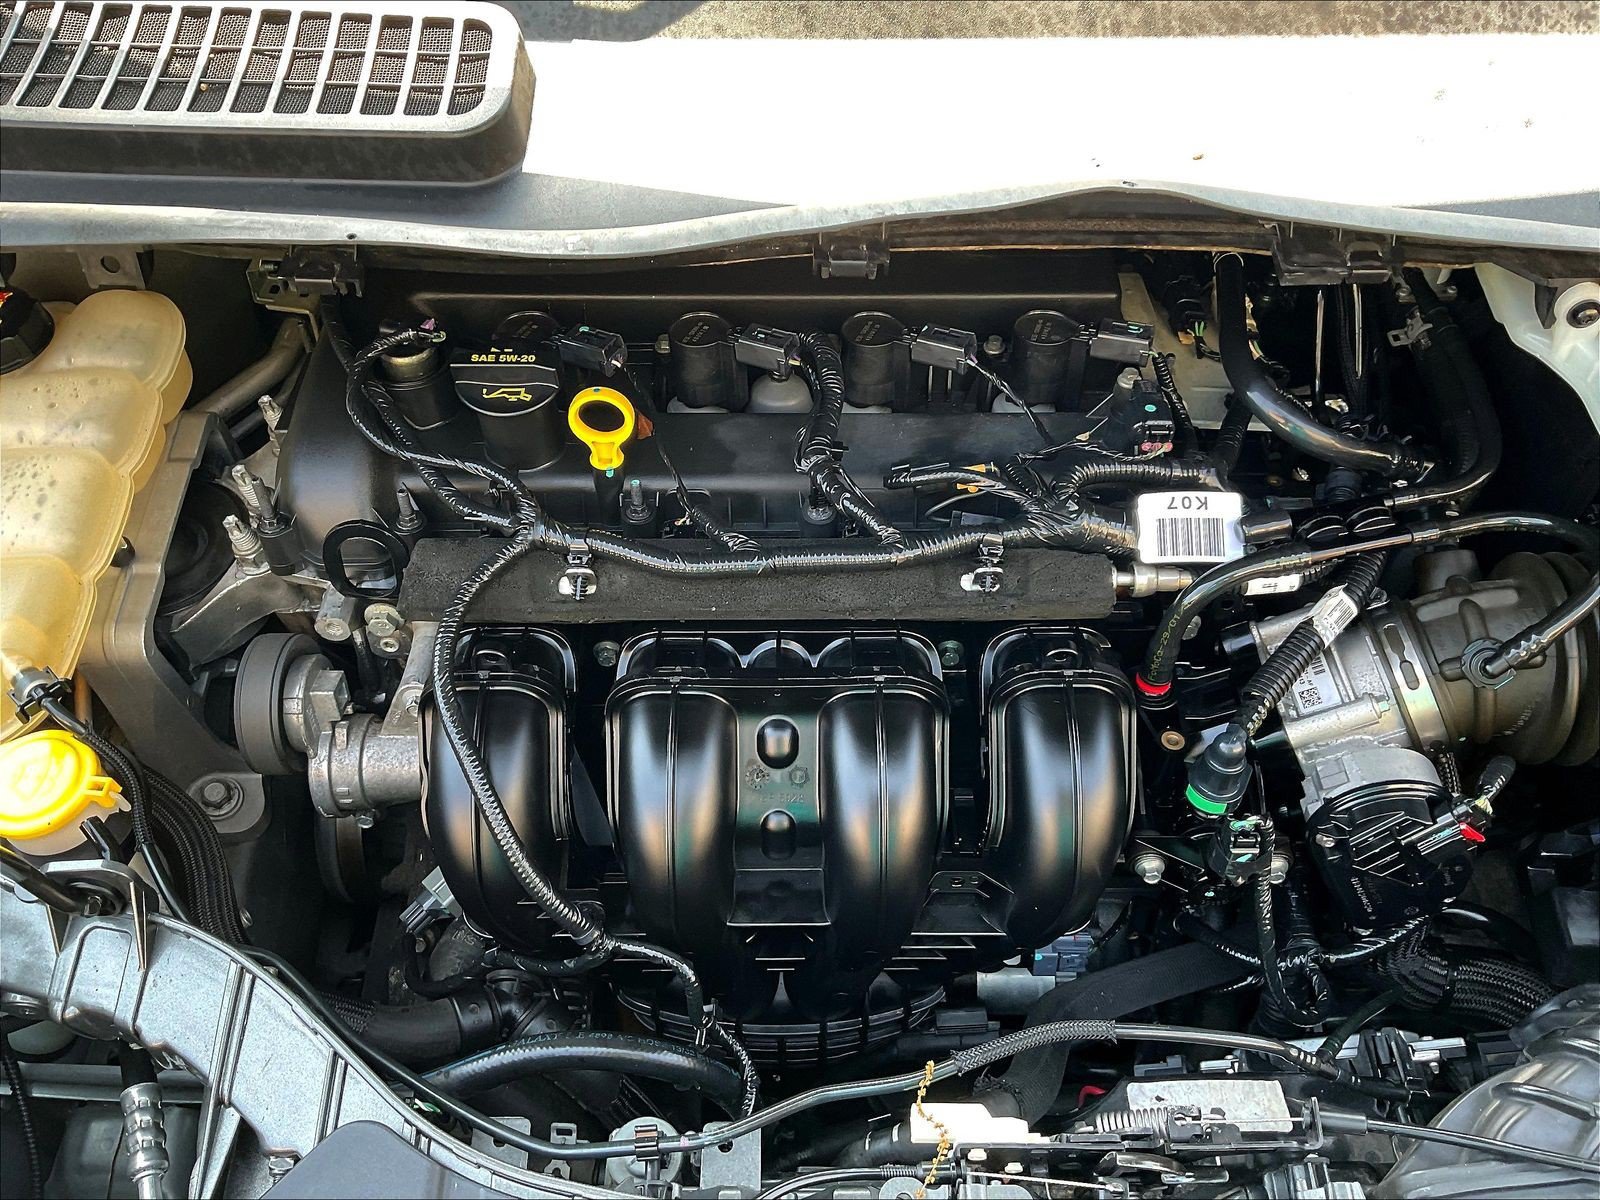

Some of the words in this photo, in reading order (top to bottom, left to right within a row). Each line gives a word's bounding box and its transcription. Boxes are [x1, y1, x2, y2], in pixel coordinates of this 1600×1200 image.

[471, 354, 496, 362] SAE
[499, 354, 536, 363] 5W-20
[1167, 496, 1208, 510] K07
